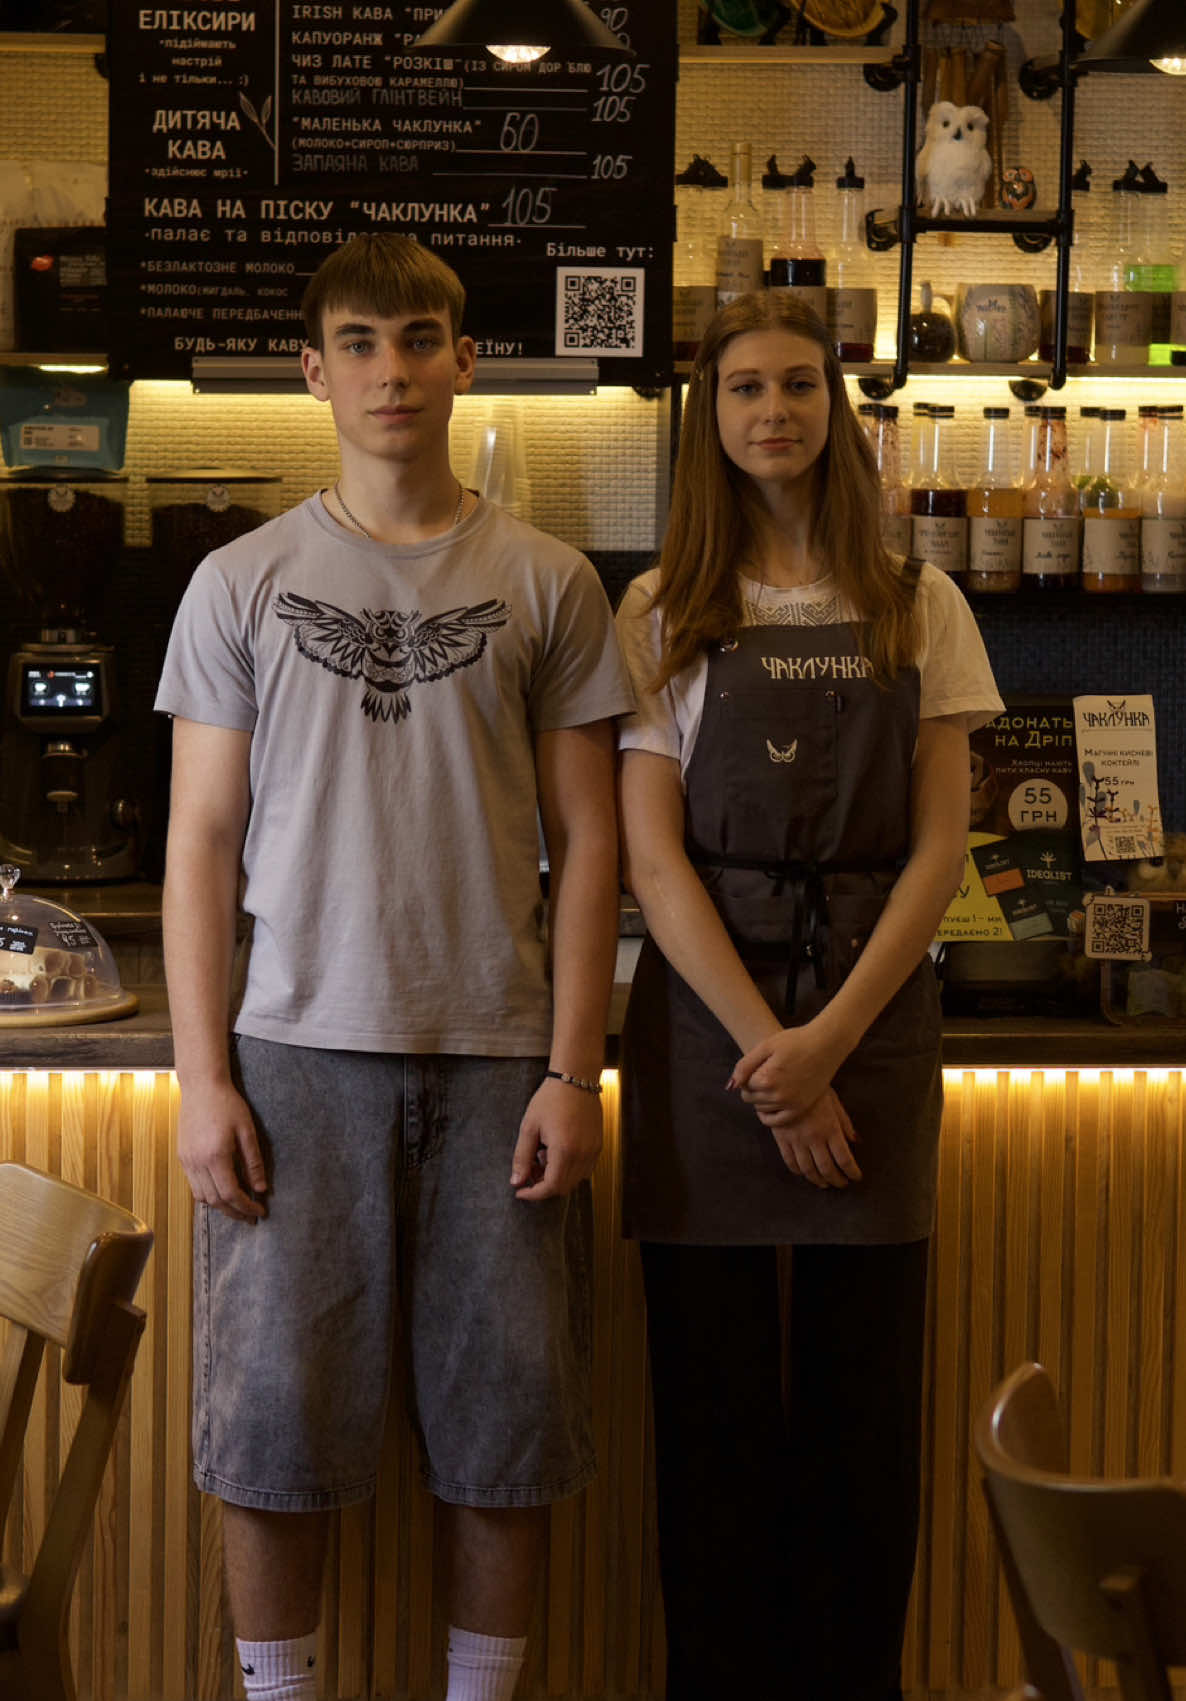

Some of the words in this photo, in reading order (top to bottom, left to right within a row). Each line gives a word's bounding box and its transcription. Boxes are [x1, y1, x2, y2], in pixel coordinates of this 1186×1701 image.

[138, 9, 257, 32] ЕЛІКСИРИ
[290, 5, 343, 20] IRISH
[352, 6, 394, 21] КАВА
[290, 31, 384, 47] КАПУОРАНЖ
[291, 54, 323, 69] ЧИЗ
[332, 55, 374, 70] ЛАТЕ
[538, 61, 562, 76] ДОР
[290, 74, 307, 86] ТА
[595, 63, 651, 94] 105
[291, 88, 362, 106] КАВОВИЙ
[372, 88, 463, 108] ГЛІНТВЕЙН
[591, 96, 637, 123] 105
[151, 108, 241, 135] ДИТЯЧА
[499, 112, 540, 152] 60
[167, 137, 227, 160] КАВА
[378, 155, 420, 173] КАВА
[591, 154, 633, 180] 105
[143, 196, 204, 220] КАВА
[216, 198, 247, 219] НА
[260, 199, 334, 221] ПІСКУ
[501, 185, 559, 226] 105
[225, 228, 248, 244] та
[546, 241, 608, 257] Більше
[616, 244, 657, 263] тут:
[244, 261, 296, 274] МОЛОКО
[174, 336, 258, 354] БУДЬ-ЯКУ
[760, 656, 873, 679] ЧАКЛУНКА
[985, 715, 1073, 731] АДОНАТЬ
[1082, 712, 1151, 728] ЧАКЛУНКА
[994, 734, 1020, 747] НА
[1023, 787, 1052, 805] 55
[1020, 810, 1057, 823] ГРН
